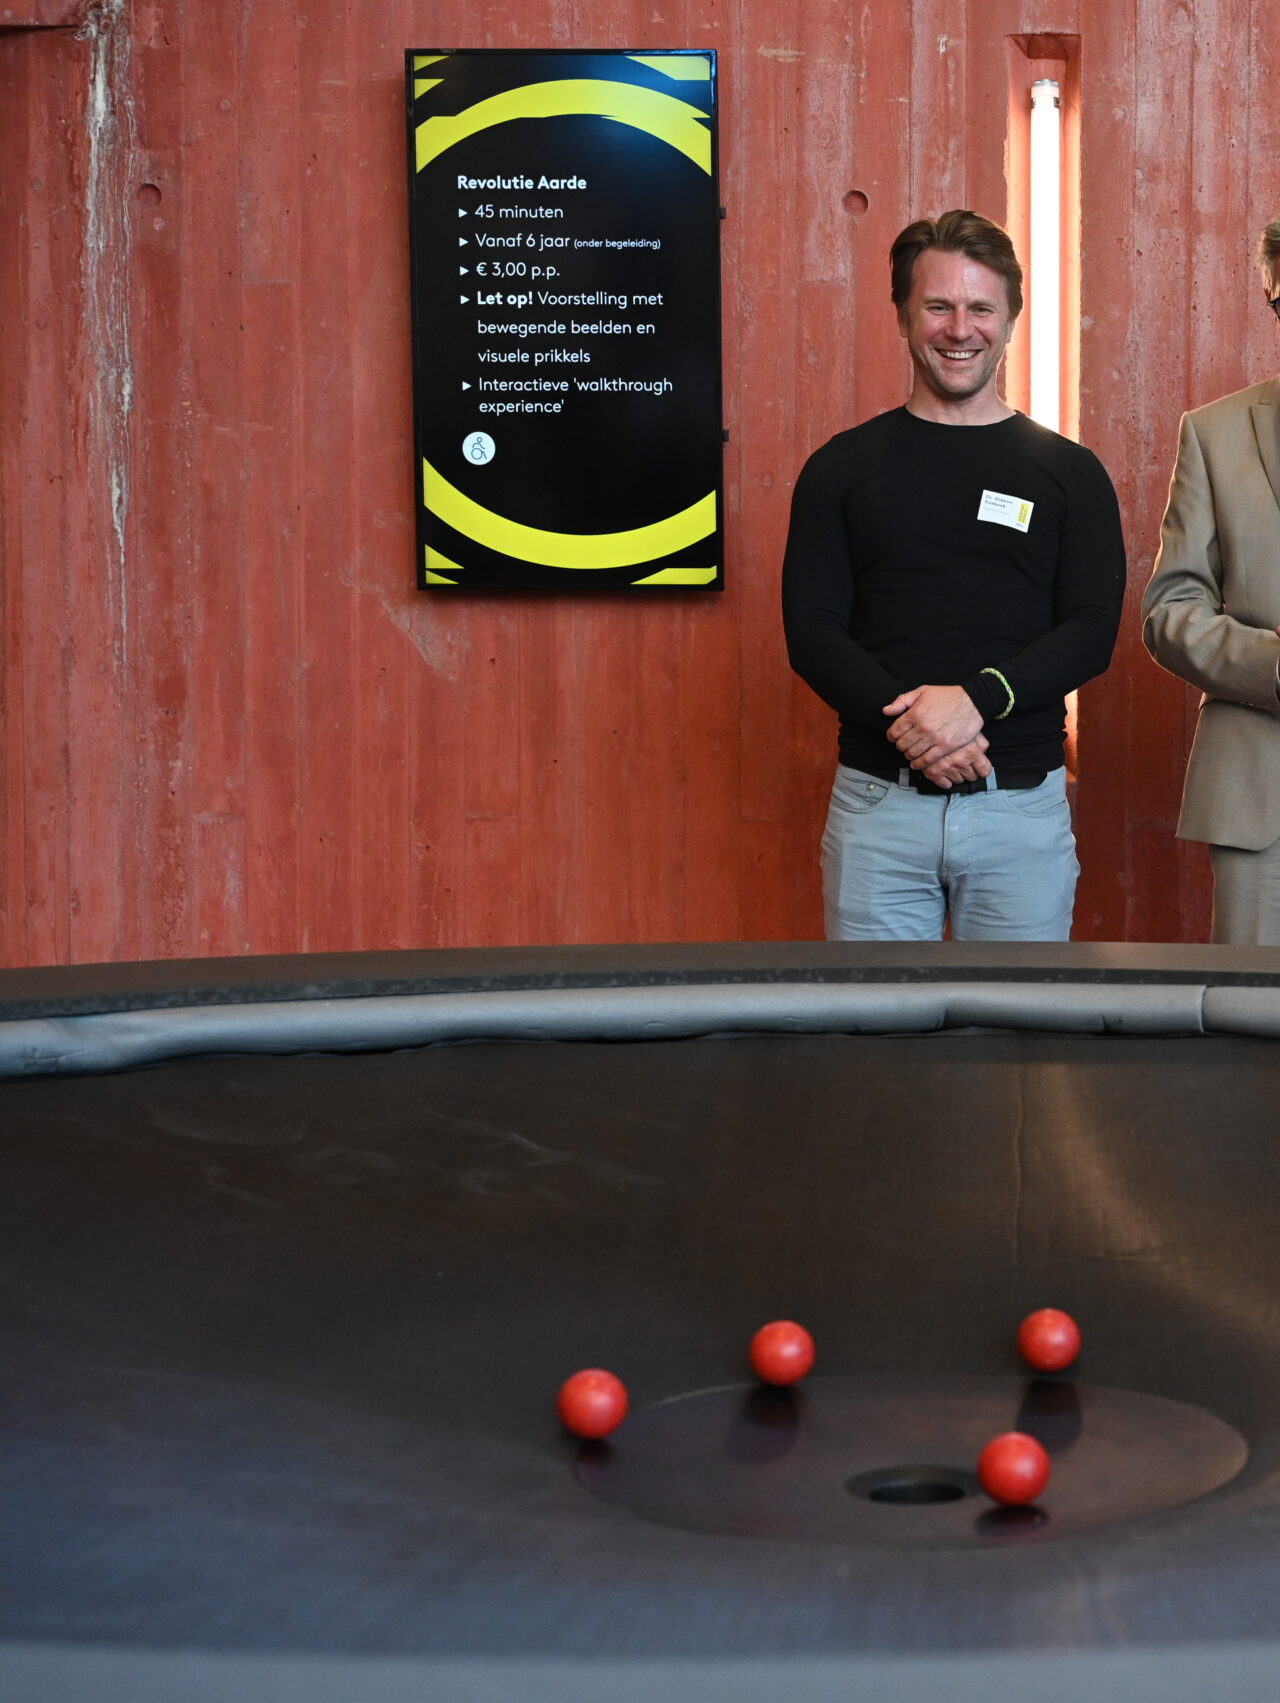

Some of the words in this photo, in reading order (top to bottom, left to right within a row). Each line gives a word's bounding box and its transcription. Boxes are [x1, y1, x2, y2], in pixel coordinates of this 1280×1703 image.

[458, 175, 533, 189] Revolutie
[538, 176, 586, 189] Aarde
[475, 205, 494, 218] 45
[500, 205, 563, 218] minuten
[475, 233, 522, 247] Vanaf
[526, 234, 535, 247] 6
[539, 234, 570, 251] jaar
[574, 239, 603, 249] (onder
[606, 239, 660, 249] begeleiding)
[476, 262, 487, 276] €
[492, 262, 526, 278] 3,00
[532, 267, 560, 280] p.p.
[478, 291, 503, 304] Let
[507, 291, 532, 308] op!
[538, 291, 627, 309] Voorstelling
[633, 293, 663, 305] met
[478, 320, 566, 337] bewegende
[572, 320, 631, 333] beelden
[637, 324, 655, 333] en
[478, 349, 529, 362] visuele
[535, 349, 590, 366] prikkels
[480, 378, 568, 391] Interactieve
[574, 378, 672, 395] 'walkthrough
[479, 399, 563, 416] experience'
